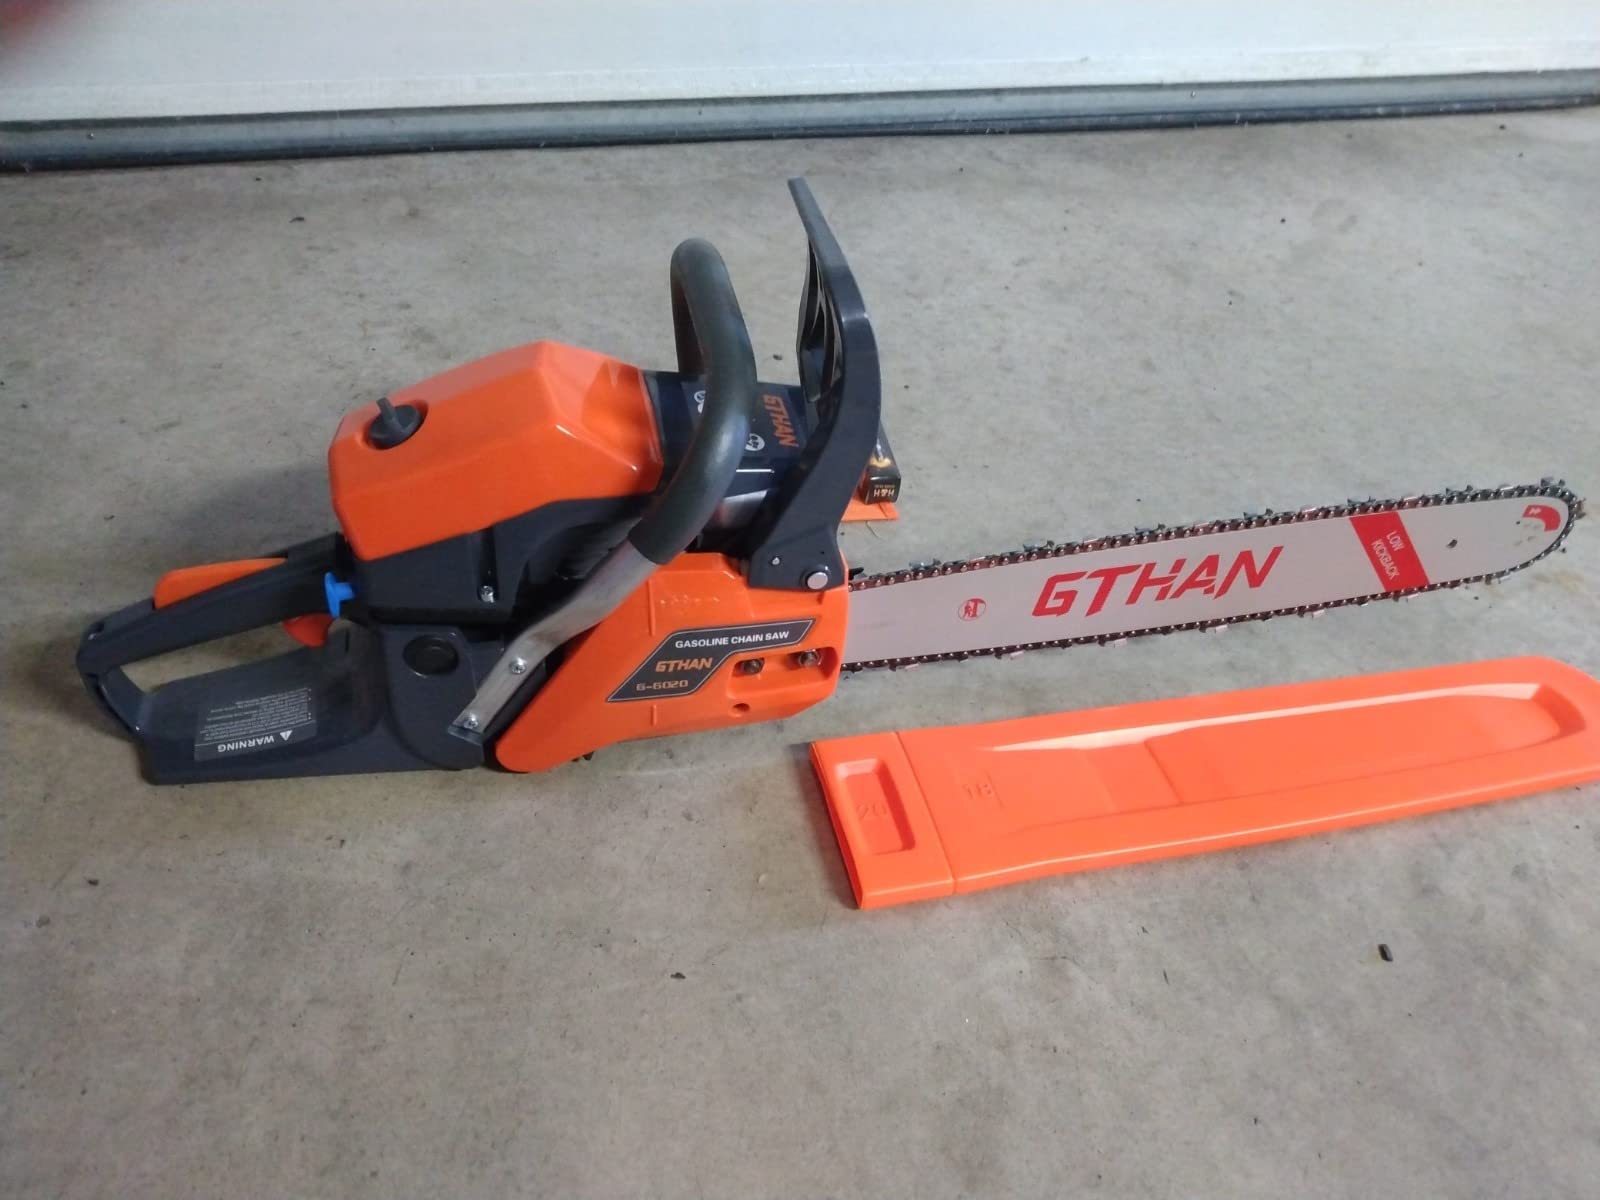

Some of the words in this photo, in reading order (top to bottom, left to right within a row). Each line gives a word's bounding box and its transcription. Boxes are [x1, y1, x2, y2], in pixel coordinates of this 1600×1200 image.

[763, 394, 799, 448] GTHAN
[1386, 530, 1405, 552] LOW
[1371, 540, 1400, 581] KICKBACK
[1031, 545, 1284, 618] GTHAN
[675, 636, 729, 649] GASOLINE
[731, 633, 764, 644] CHAIN
[765, 631, 790, 641] SAW
[655, 657, 713, 673] GTHAN
[217, 735, 275, 753] WARNING
